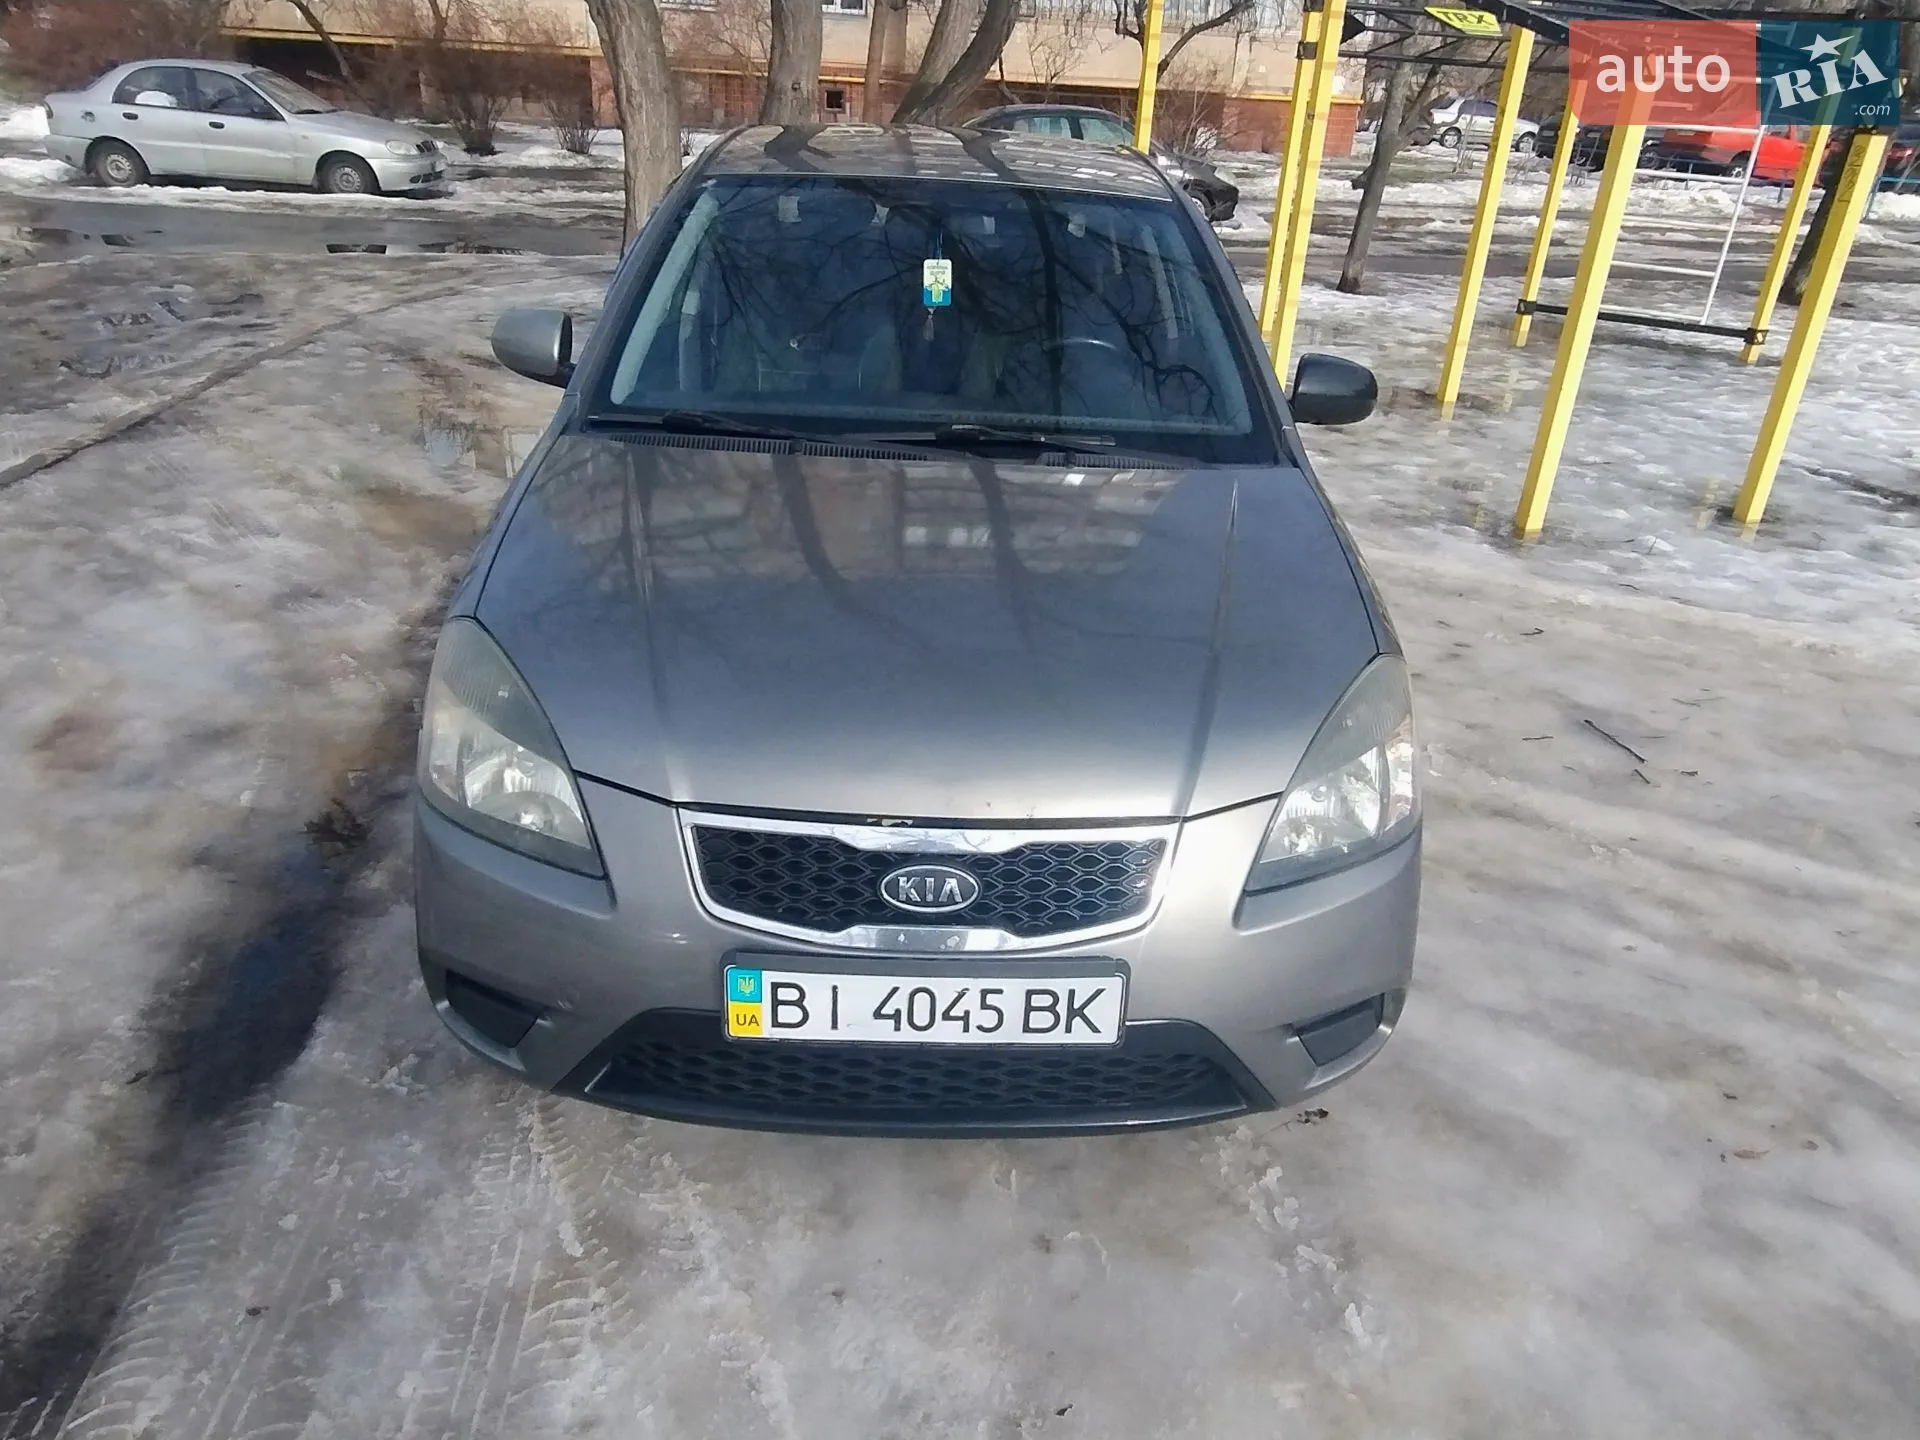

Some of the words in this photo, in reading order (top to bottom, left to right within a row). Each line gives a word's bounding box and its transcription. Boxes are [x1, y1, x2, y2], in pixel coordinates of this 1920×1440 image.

[1436, 10, 1495, 25] TRX
[897, 876, 963, 902] KIA
[872, 986, 1005, 1033] 4045
[1022, 988, 1106, 1033] BK
[735, 1013, 760, 1027] UA
